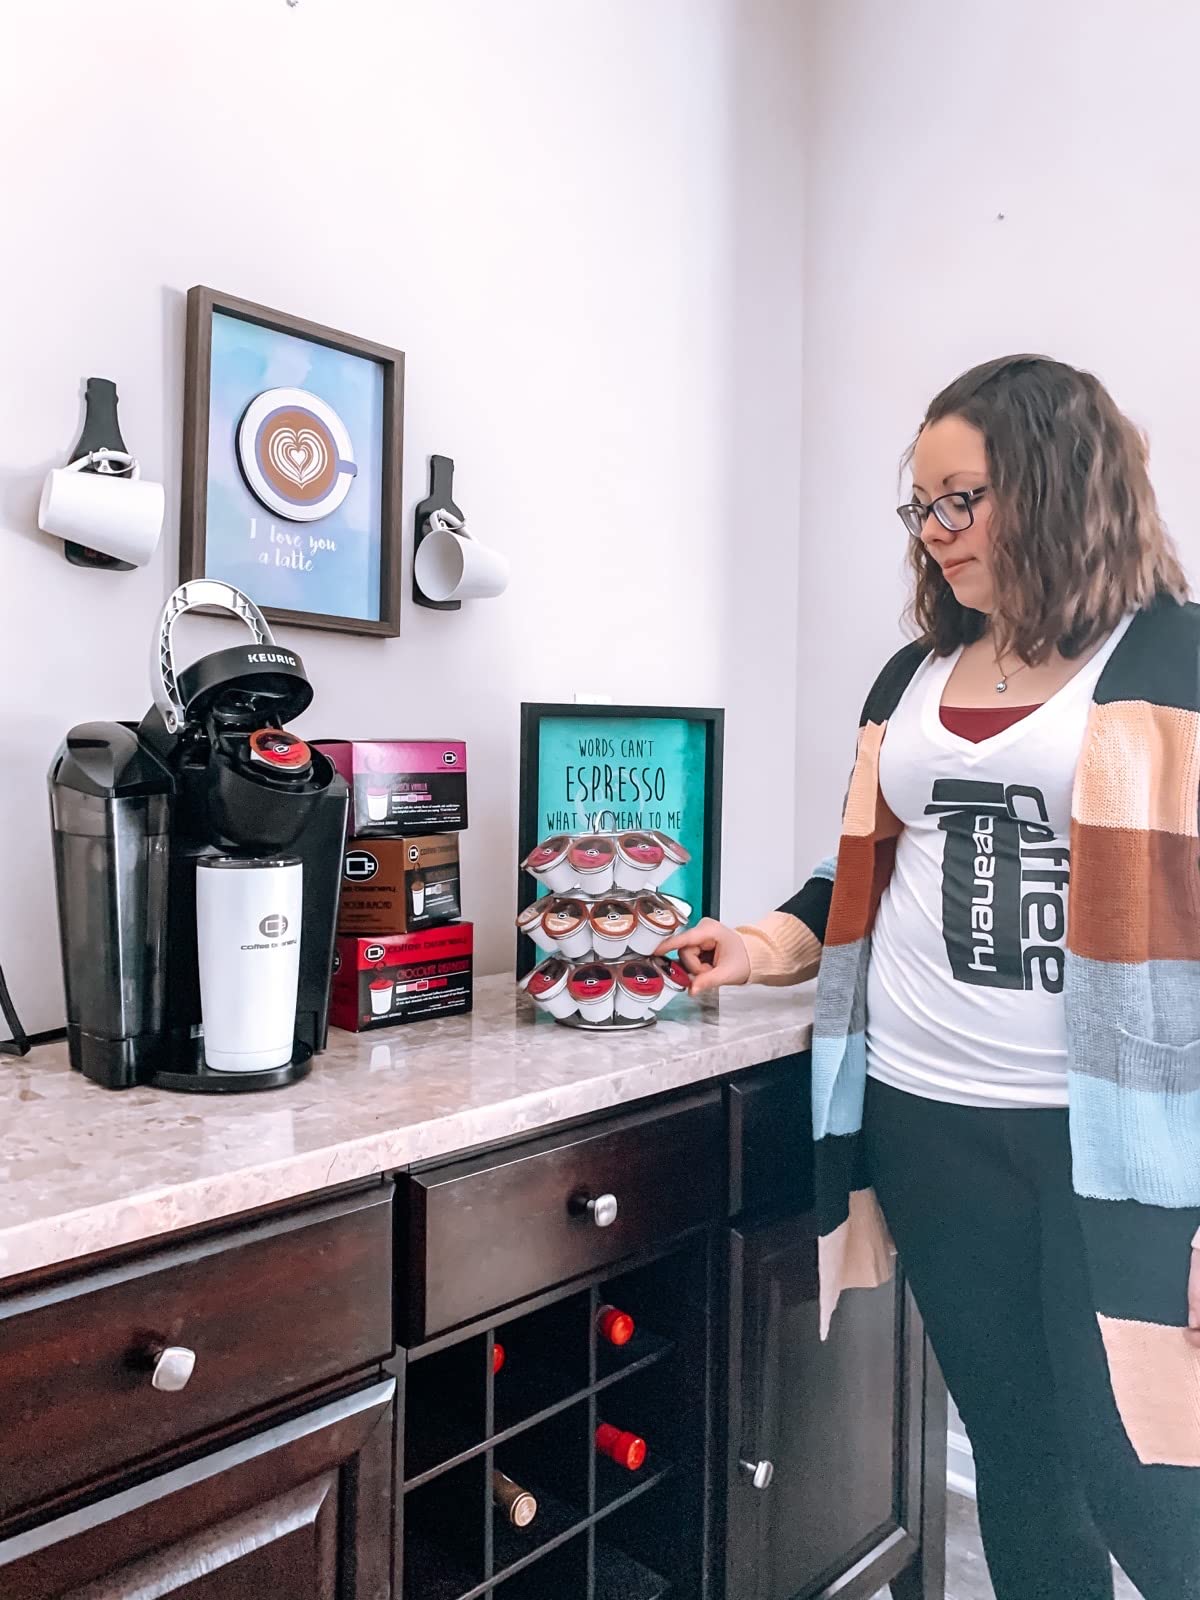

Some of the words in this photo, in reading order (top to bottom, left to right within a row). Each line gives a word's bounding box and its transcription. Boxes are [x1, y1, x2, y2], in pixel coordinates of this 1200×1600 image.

[250, 518, 257, 539] I
[270, 524, 302, 547] love
[308, 535, 337, 556] you
[258, 551, 269, 565] a
[275, 548, 314, 572] latte
[247, 653, 297, 667] KEURIG
[578, 738, 615, 758] WORDS
[621, 739, 655, 758] CAN'T
[566, 764, 666, 802] ESPRESSO
[547, 811, 578, 831] WHAT
[585, 811, 606, 830] YOU
[614, 811, 643, 830] MEAN
[649, 811, 662, 830] TO
[667, 811, 681, 830] ME
[968, 815, 997, 972] beanery
